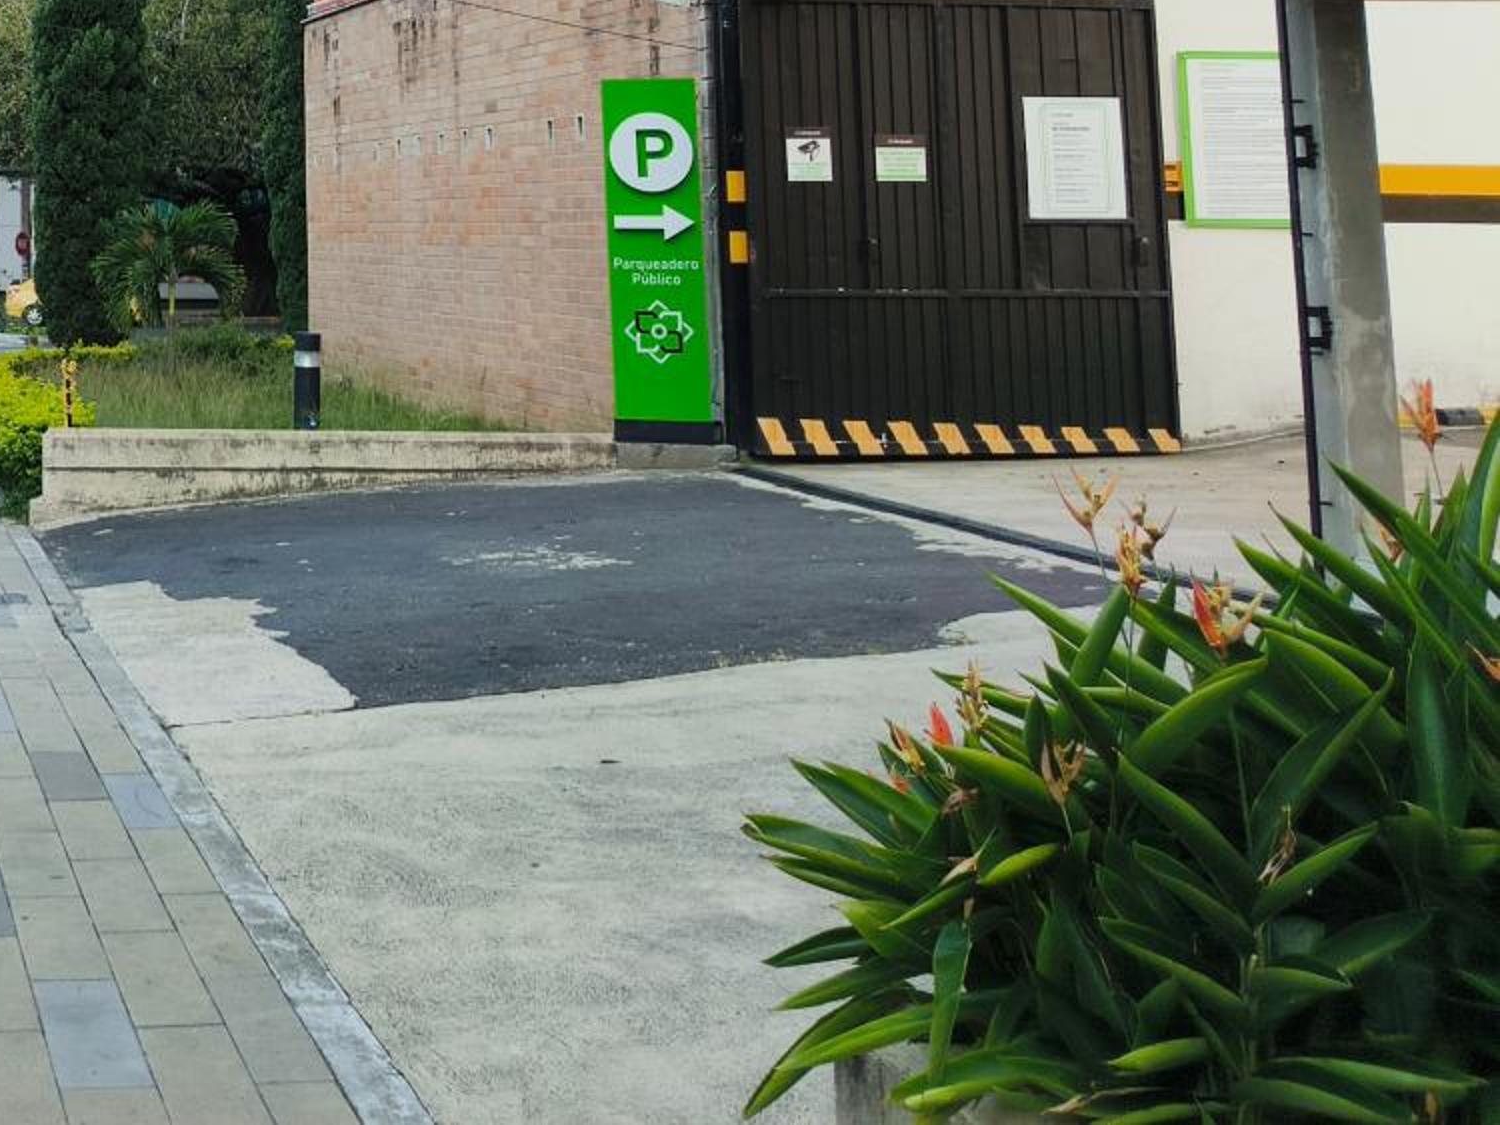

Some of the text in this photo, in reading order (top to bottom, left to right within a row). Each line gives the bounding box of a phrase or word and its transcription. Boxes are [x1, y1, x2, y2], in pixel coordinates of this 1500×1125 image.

[635, 128, 674, 178] P
[612, 256, 700, 272] Parqueadero
[631, 272, 682, 286] Público
